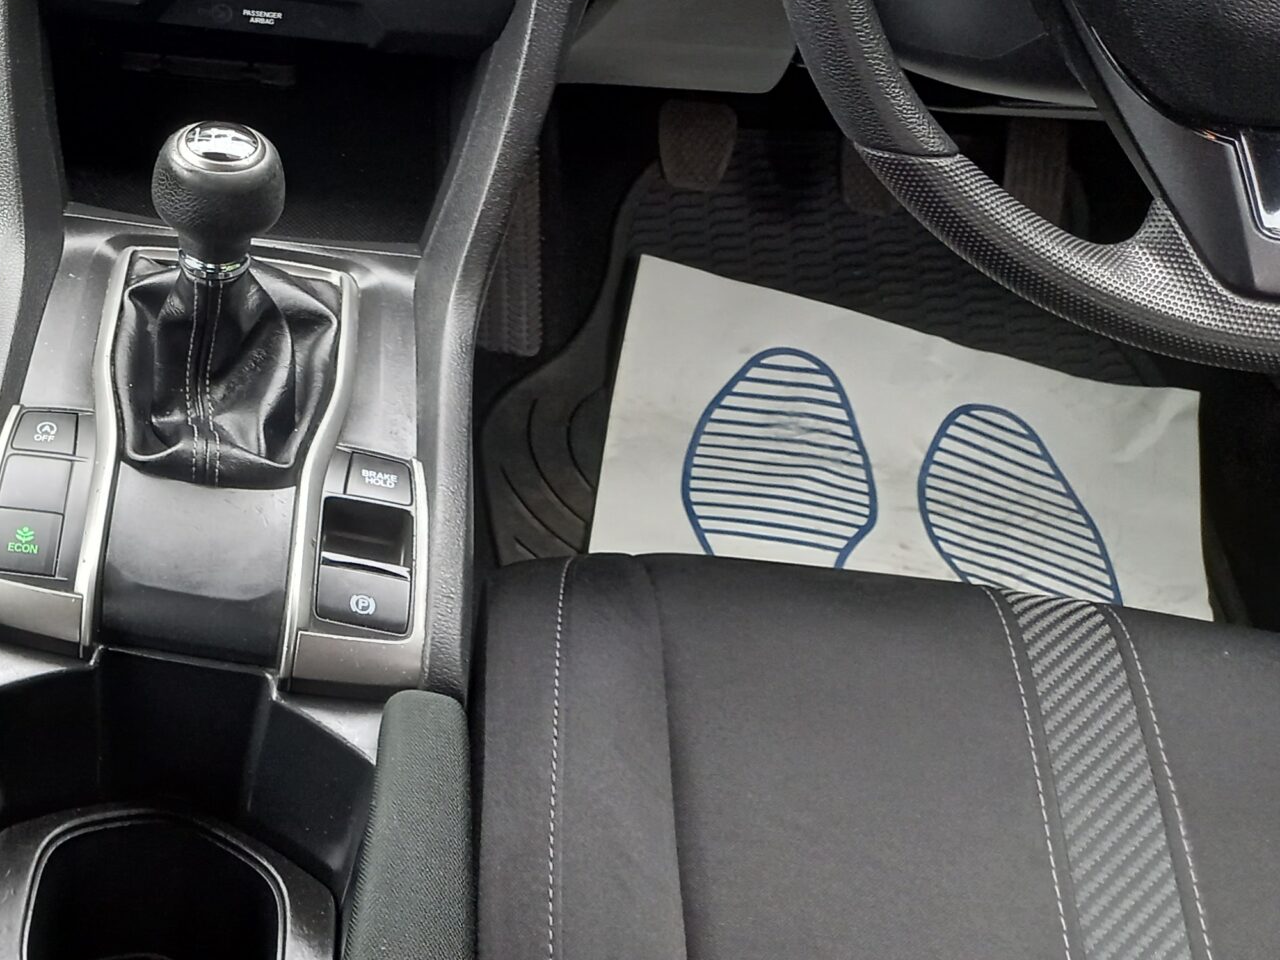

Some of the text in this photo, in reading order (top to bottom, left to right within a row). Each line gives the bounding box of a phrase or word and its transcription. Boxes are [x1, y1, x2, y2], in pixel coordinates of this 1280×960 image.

[242, 9, 283, 20] PASSENGER
[249, 16, 275, 26] AIRBAG
[34, 434, 55, 442] OFF
[361, 469, 398, 483] BRAKE
[365, 477, 395, 489] HOLD
[7, 542, 38, 554] ECON
